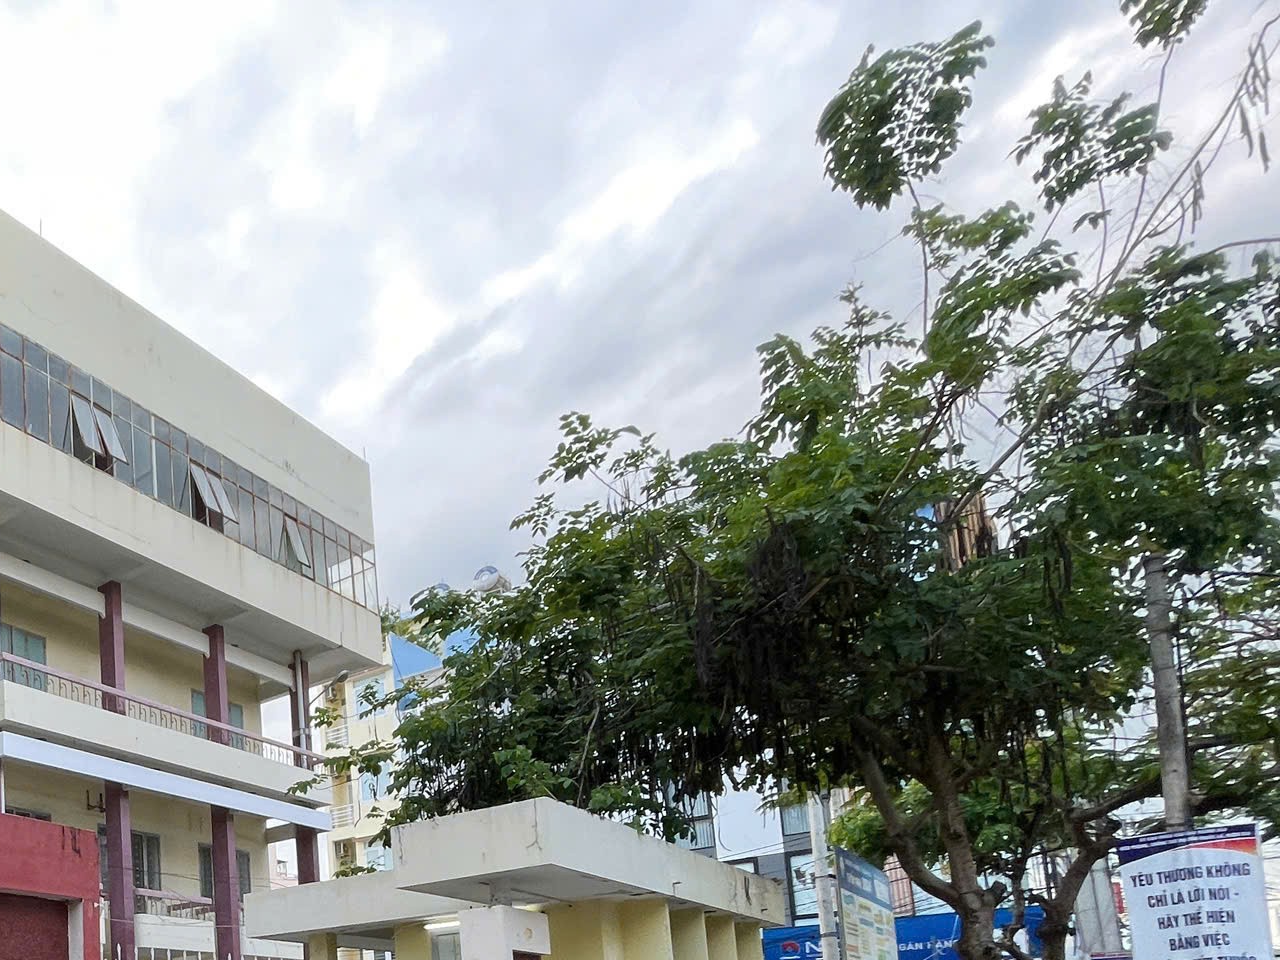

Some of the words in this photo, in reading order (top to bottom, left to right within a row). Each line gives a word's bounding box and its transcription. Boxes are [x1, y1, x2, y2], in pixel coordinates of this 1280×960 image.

[1130, 871, 1153, 888] YÊU
[1206, 861, 1251, 877] KHÔNG
[1206, 908, 1236, 926] HIỆN
[1202, 930, 1230, 949] VIỆC
